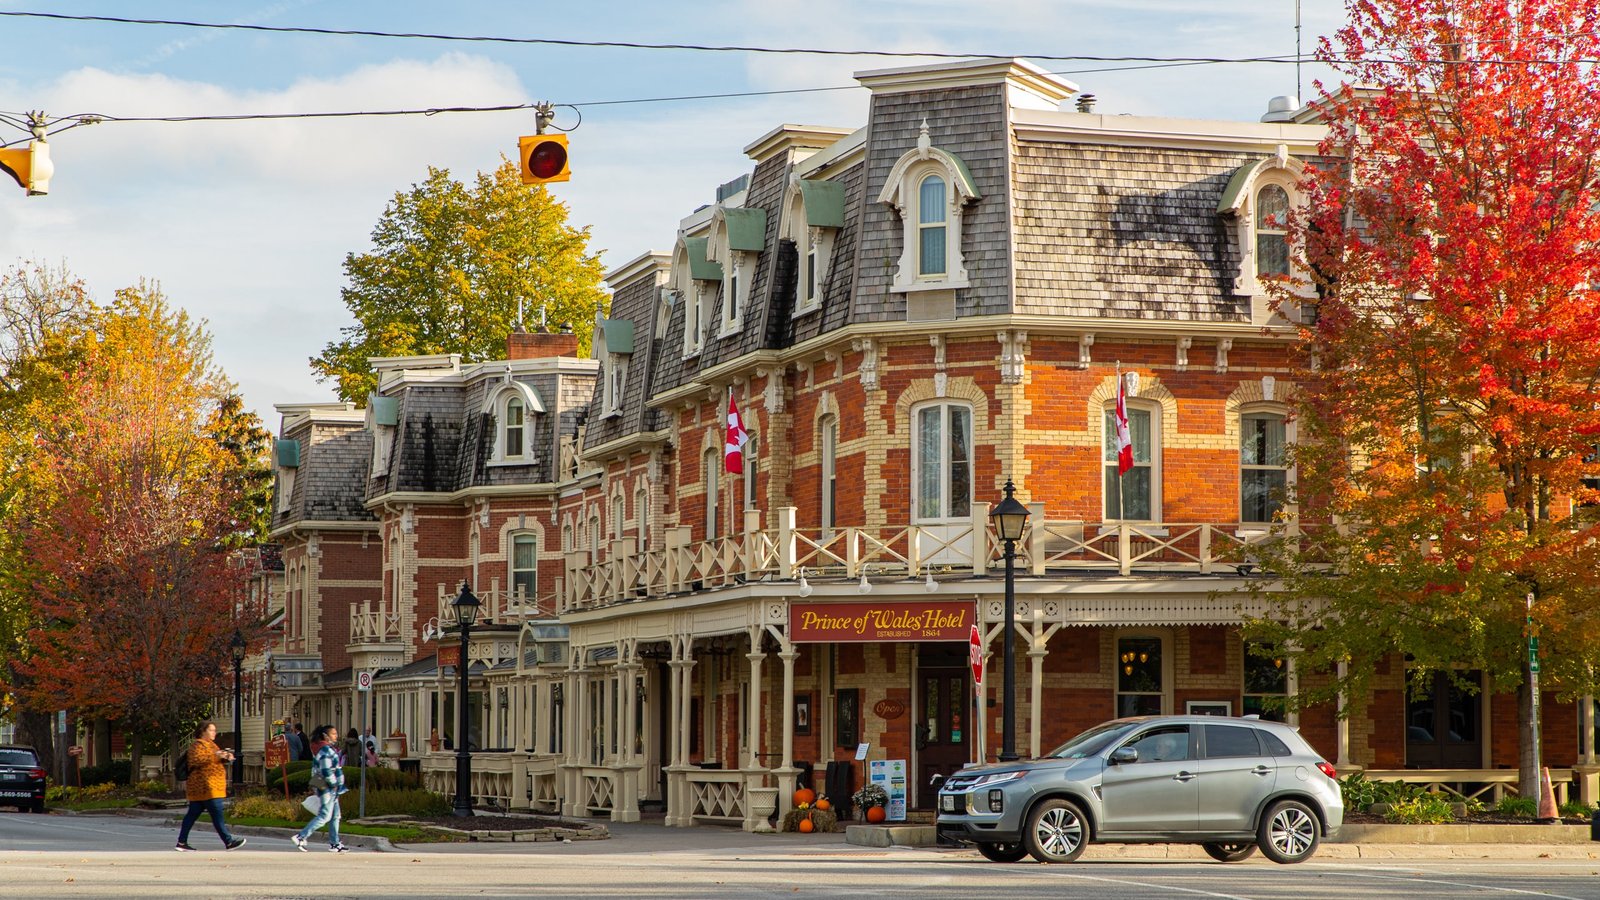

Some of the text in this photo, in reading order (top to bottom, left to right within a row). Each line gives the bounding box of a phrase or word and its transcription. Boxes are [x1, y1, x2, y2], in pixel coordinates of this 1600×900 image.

[801, 609, 965, 634] Prince of Wales Hotel
[877, 630, 911, 638] ESTABLISHED
[876, 702, 903, 716] Open
